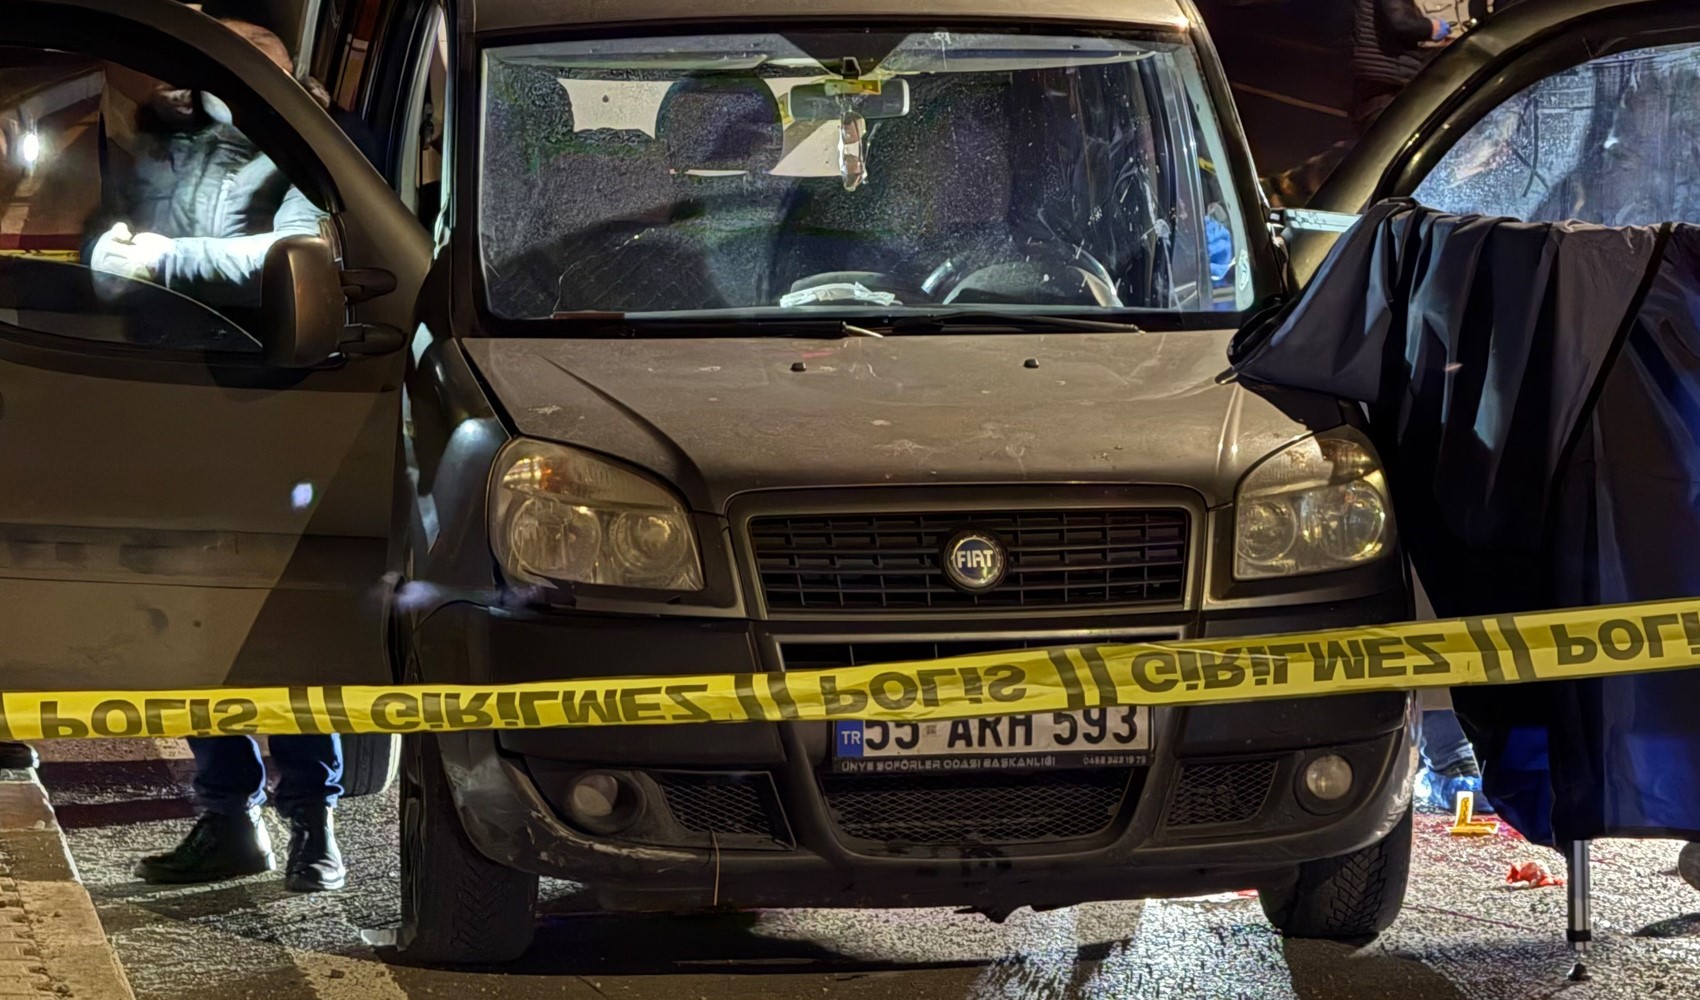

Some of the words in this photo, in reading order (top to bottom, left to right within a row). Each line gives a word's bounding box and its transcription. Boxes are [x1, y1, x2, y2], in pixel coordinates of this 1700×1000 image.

[957, 550, 993, 568] FIAT
[1053, 705, 1138, 746] 593
[841, 731, 861, 746] TR
